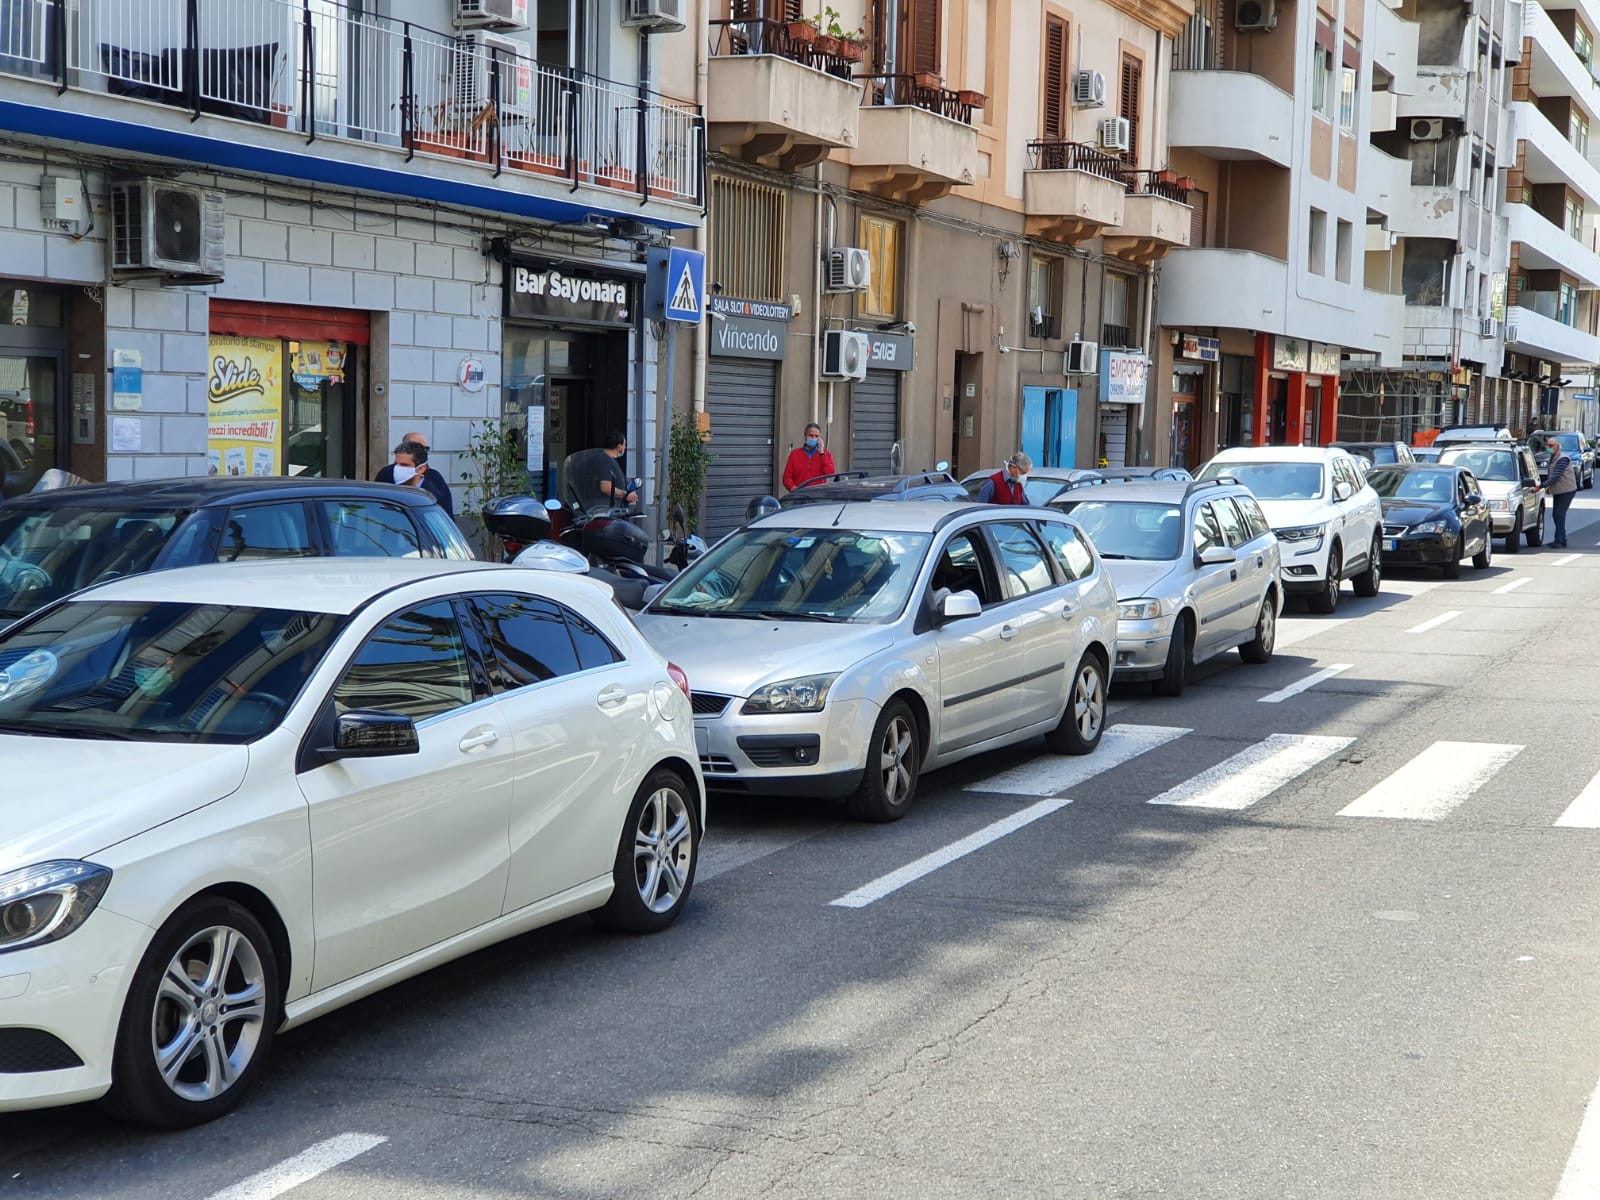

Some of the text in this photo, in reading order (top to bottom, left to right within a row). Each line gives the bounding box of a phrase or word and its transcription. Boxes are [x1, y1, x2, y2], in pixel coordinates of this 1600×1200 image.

[515, 267, 626, 304] Bar Sayonara
[714, 299, 730, 312] SALA
[730, 300, 744, 314] SLOT
[750, 303, 789, 319] VIDEOLOTTERY
[210, 355, 260, 397] Slide
[1110, 359, 1145, 378] EMPORIO
